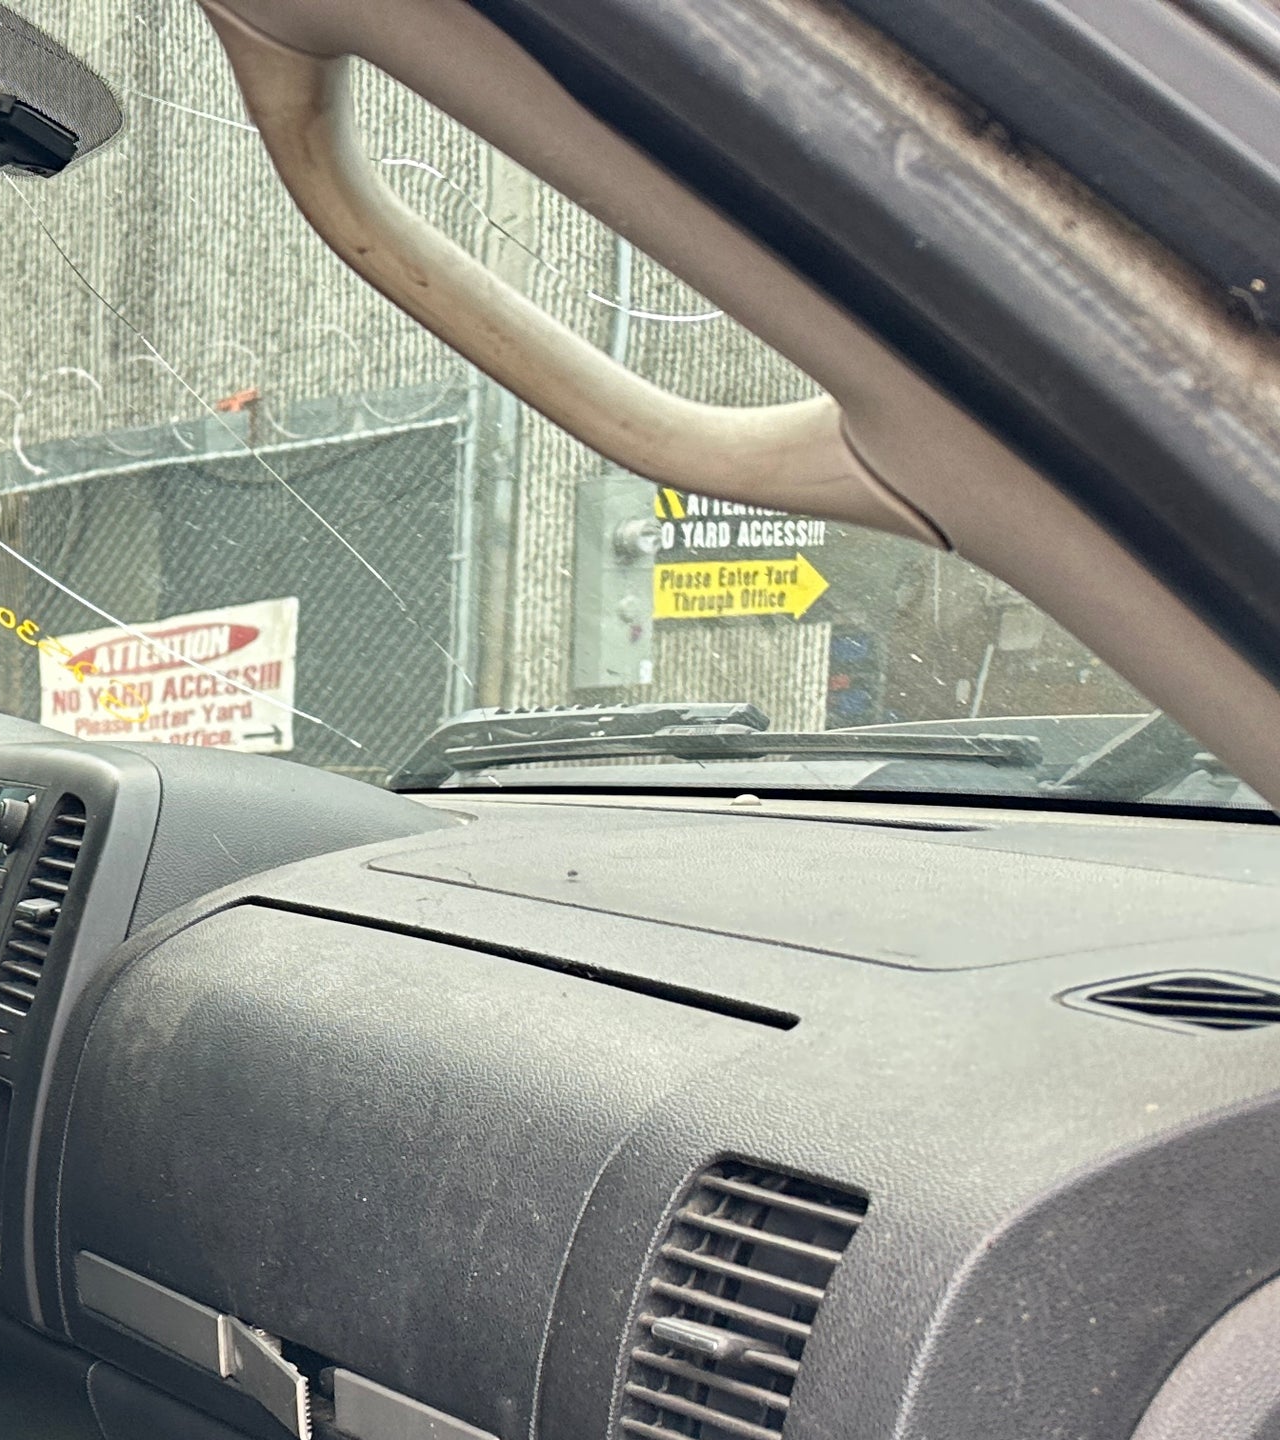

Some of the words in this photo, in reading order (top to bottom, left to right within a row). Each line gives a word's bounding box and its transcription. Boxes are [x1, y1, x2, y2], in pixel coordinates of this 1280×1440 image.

[658, 520, 675, 549] O
[681, 521, 731, 548] YARD
[737, 520, 826, 547] ACCESS!!!
[660, 568, 712, 591] Please
[718, 566, 759, 588] Enter
[765, 564, 799, 586] Yard
[673, 591, 734, 614] Through
[740, 588, 787, 610] Office
[91, 624, 231, 675] ATTENTION
[52, 689, 81, 715] NO
[203, 700, 253, 723] Yard
